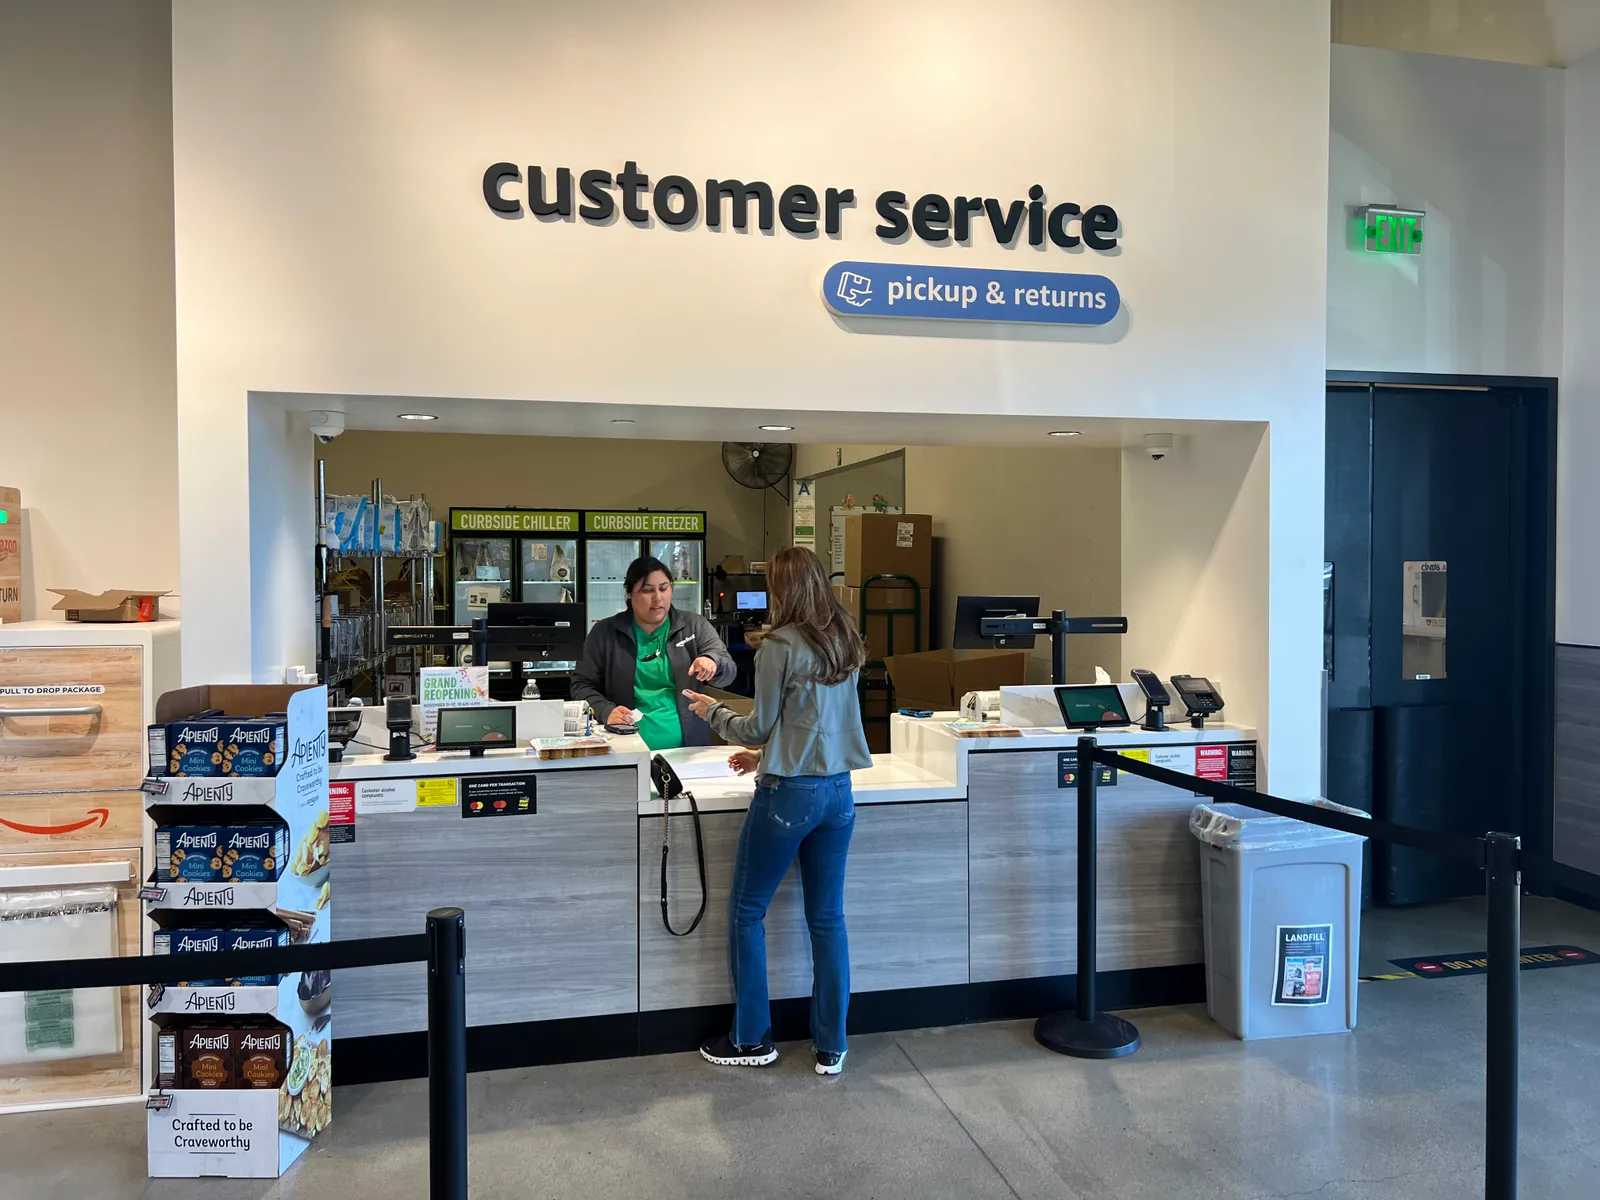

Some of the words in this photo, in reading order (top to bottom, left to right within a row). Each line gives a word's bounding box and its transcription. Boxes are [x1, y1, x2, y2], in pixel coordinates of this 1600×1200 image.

[483, 160, 855, 240] customer
[875, 184, 1118, 251] service
[1376, 215, 1416, 253] EXIT
[887, 276, 977, 308] pickup
[985, 281, 1006, 304] &
[1013, 284, 1107, 310] returns
[798, 481, 810, 496] A
[460, 514, 519, 529] CURBSIDE
[522, 516, 571, 530] CHILLER
[593, 515, 649, 531] CURBSIDE
[652, 516, 699, 530] FREEZER
[424, 677, 457, 689] GRAND
[62, 686, 101, 694] PACKAGE
[424, 688, 478, 701] REOPENING
[178, 727, 219, 743] APLENTY
[230, 727, 270, 743] APLENTY
[291, 729, 326, 768] APLENTY
[189, 756, 205, 765] Mini
[241, 757, 257, 765] Mini
[183, 764, 211, 773] Cookies
[235, 764, 263, 773] Cookies
[183, 782, 233, 802] APLENTY
[329, 787, 349, 795] RNING:
[176, 832, 217, 848] APLENTY
[228, 832, 270, 849] APLENTY
[188, 862, 205, 870] Mini
[241, 862, 258, 870] Mini
[182, 869, 211, 878] Cookies
[235, 869, 264, 878] Cookies
[184, 887, 234, 906] APLENTY
[1285, 932, 1325, 942] LANDFILL
[178, 936, 218, 952] APLENTY
[1442, 960, 1473, 970] DO
[185, 991, 235, 1011] APLENTY
[189, 1033, 229, 1050] APLENTY
[240, 1033, 281, 1050] APLENTY
[201, 1062, 217, 1070] Mini
[253, 1062, 269, 1070] Mini
[195, 1070, 223, 1078] Cookies
[247, 1070, 274, 1078] Cookies
[172, 1118, 220, 1131] Crafted
[224, 1119, 236, 1131] to
[239, 1118, 253, 1131] be
[174, 1135, 251, 1151] Craveworthy
